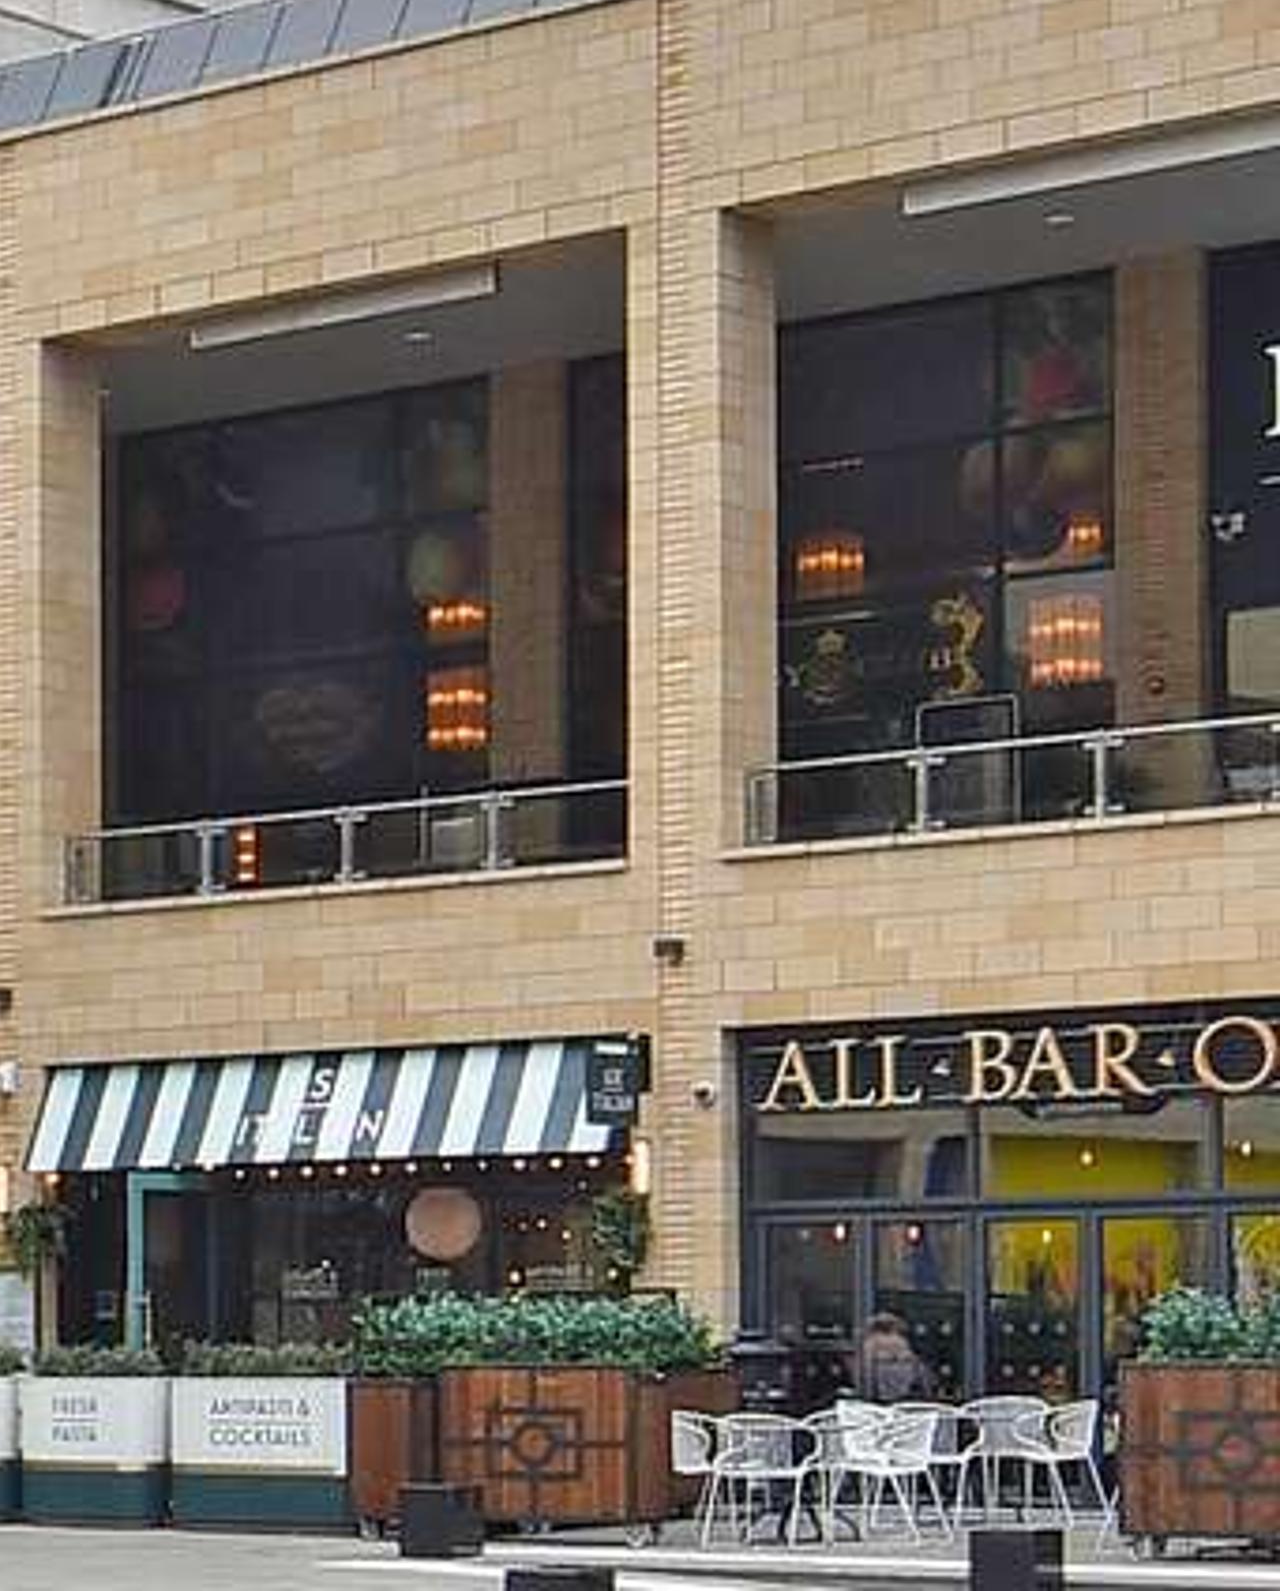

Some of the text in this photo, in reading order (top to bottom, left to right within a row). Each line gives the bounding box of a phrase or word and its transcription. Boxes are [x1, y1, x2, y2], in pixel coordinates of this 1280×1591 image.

[758, 1015, 1280, 1111] ALL BAR O
